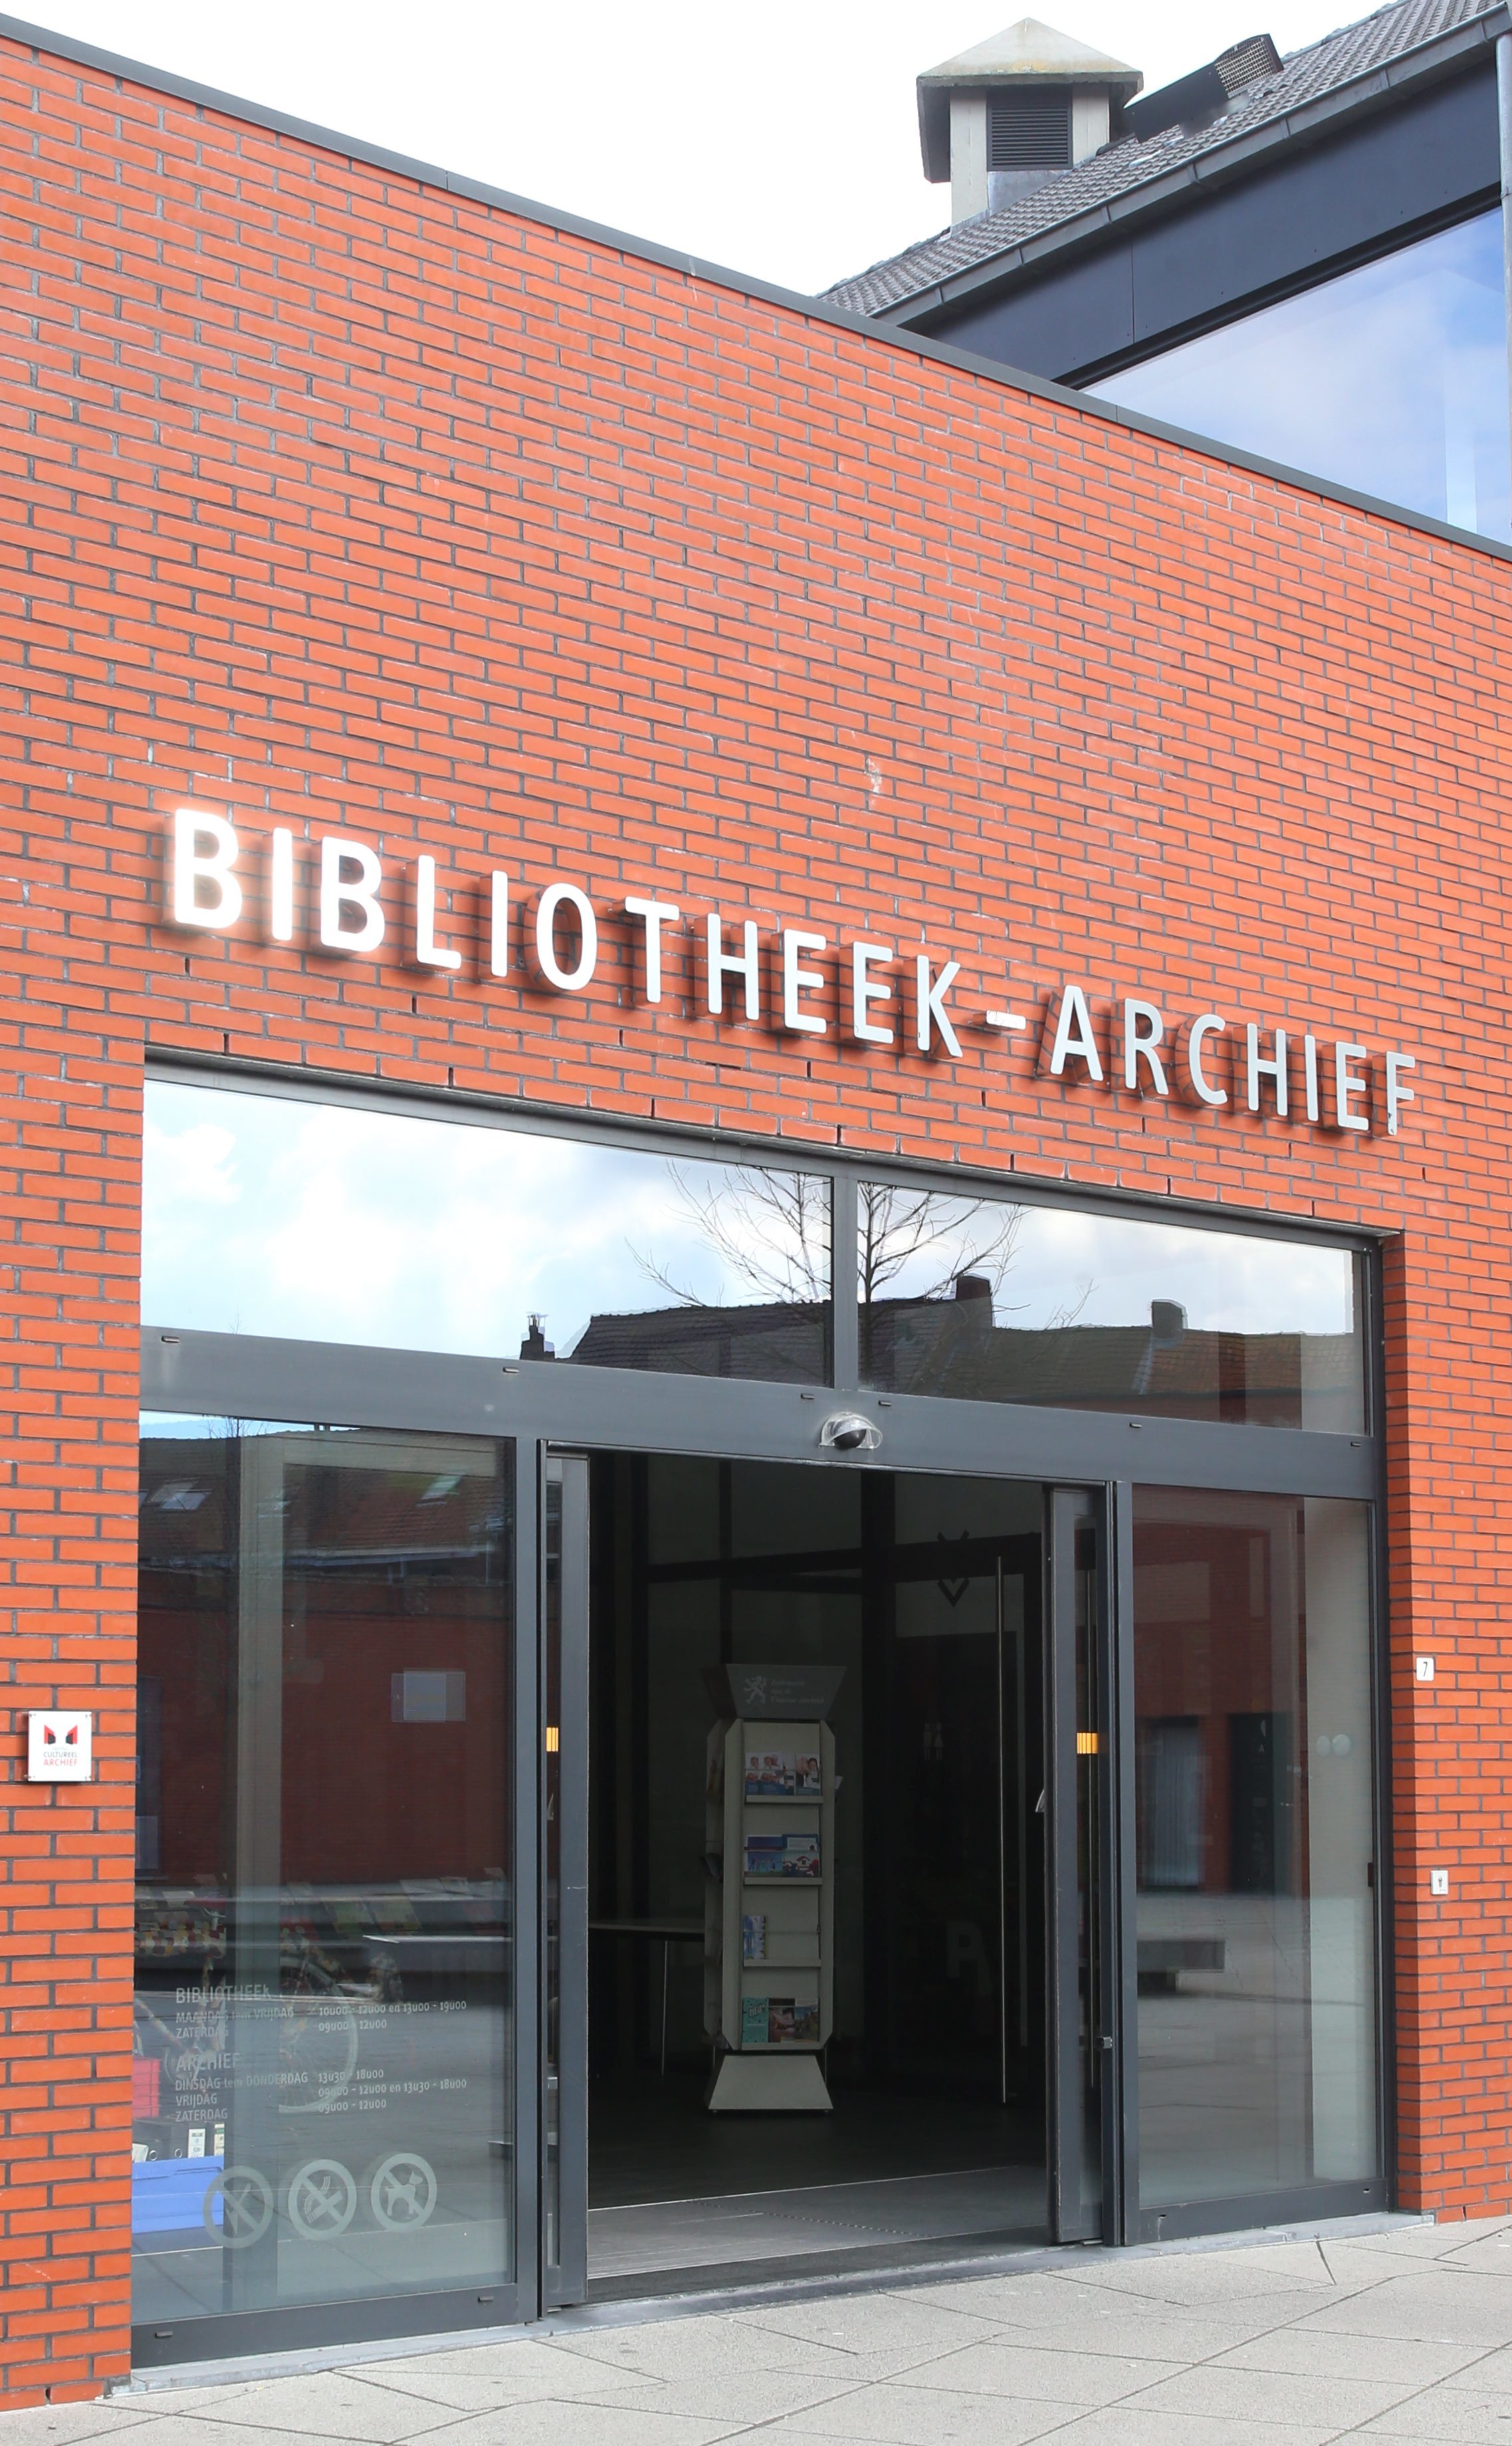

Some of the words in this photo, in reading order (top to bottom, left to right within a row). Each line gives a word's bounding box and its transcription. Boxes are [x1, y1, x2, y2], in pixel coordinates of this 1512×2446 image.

[1423, 1661, 1428, 1677] 7
[175, 2009, 229, 2023] MAANDAG
[253, 2007, 294, 2021] VRIJDAG
[320, 2006, 348, 2017] 10u00
[358, 2003, 385, 2015] 12u00
[403, 2002, 430, 2015] 13u00
[440, 2000, 467, 2013] 19u00
[175, 2025, 229, 2039] ZATERDAG
[318, 2020, 348, 2033] 09u00
[359, 2019, 387, 2030] 12u00
[175, 2053, 241, 2072] ARCHIEF
[175, 2078, 221, 2092] DINSDAG
[246, 2071, 308, 2087] DONDERDAG
[318, 2070, 346, 2084] 13u30
[356, 2068, 384, 2080] 18u00
[175, 2092, 218, 2108] VRIJDAG
[318, 2086, 349, 2099] 09u00
[359, 2083, 387, 2095] 12u00
[389, 2084, 401, 2092] en
[403, 2080, 430, 2094] 13u30
[440, 2078, 467, 2090] 18u00
[175, 2107, 228, 2122] ZATERDAG
[318, 2101, 349, 2114] 09u00
[359, 2098, 387, 2110] 12u00
